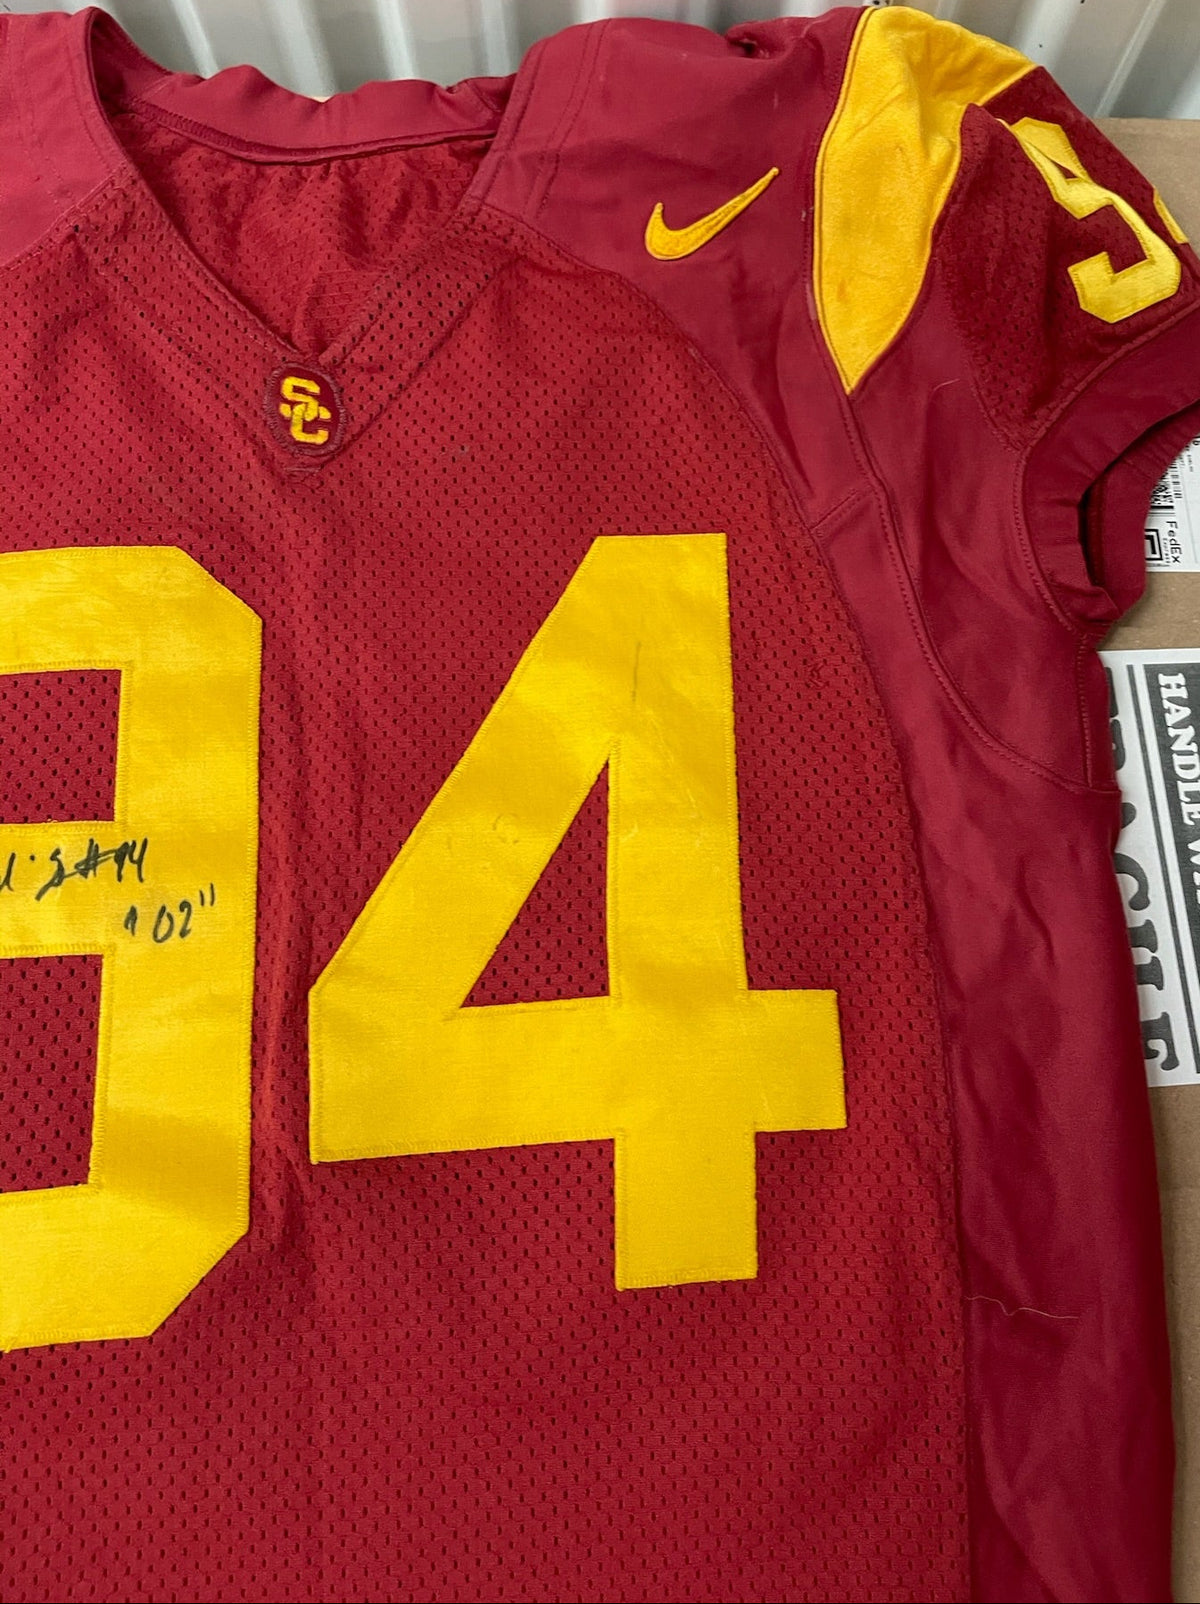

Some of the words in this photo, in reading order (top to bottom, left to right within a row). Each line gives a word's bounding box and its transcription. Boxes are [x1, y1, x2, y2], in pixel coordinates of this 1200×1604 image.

[279, 375, 332, 445] SC
[1166, 520, 1182, 564] FedEx
[1158, 672, 1200, 826] HANDLE
